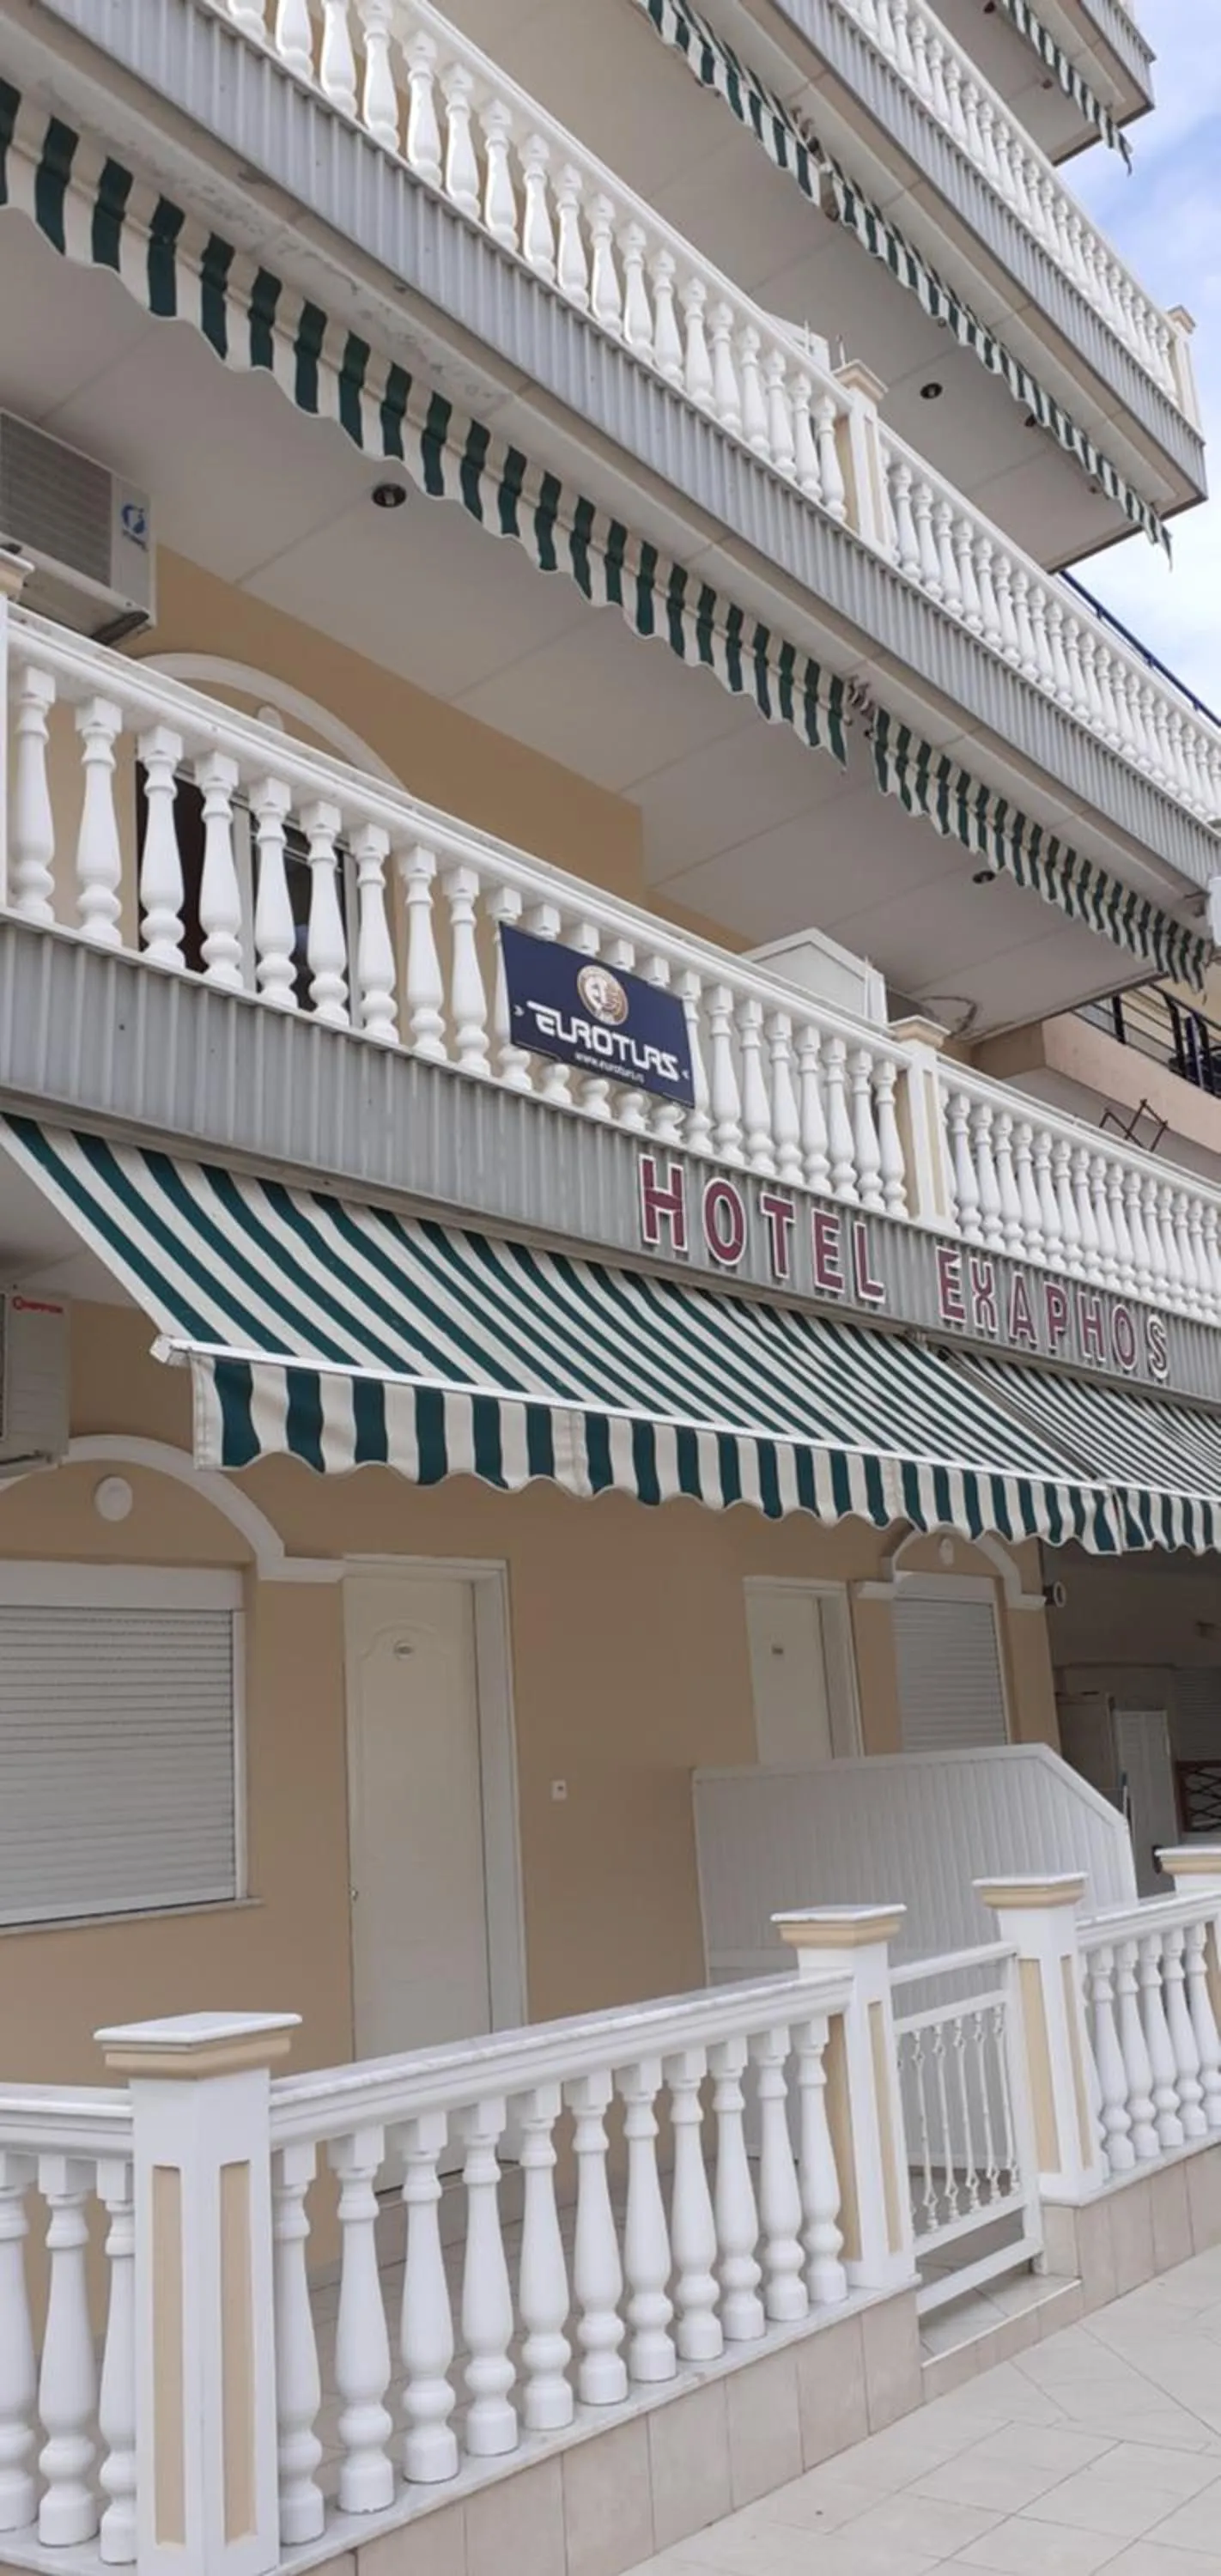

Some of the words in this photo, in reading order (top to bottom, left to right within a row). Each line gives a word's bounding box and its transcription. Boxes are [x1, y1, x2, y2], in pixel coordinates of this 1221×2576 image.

[526, 1000, 680, 1082] EUROTURS
[638, 1154, 886, 1304] HOTEL
[936, 1244, 1170, 1379] EXAPHOS
